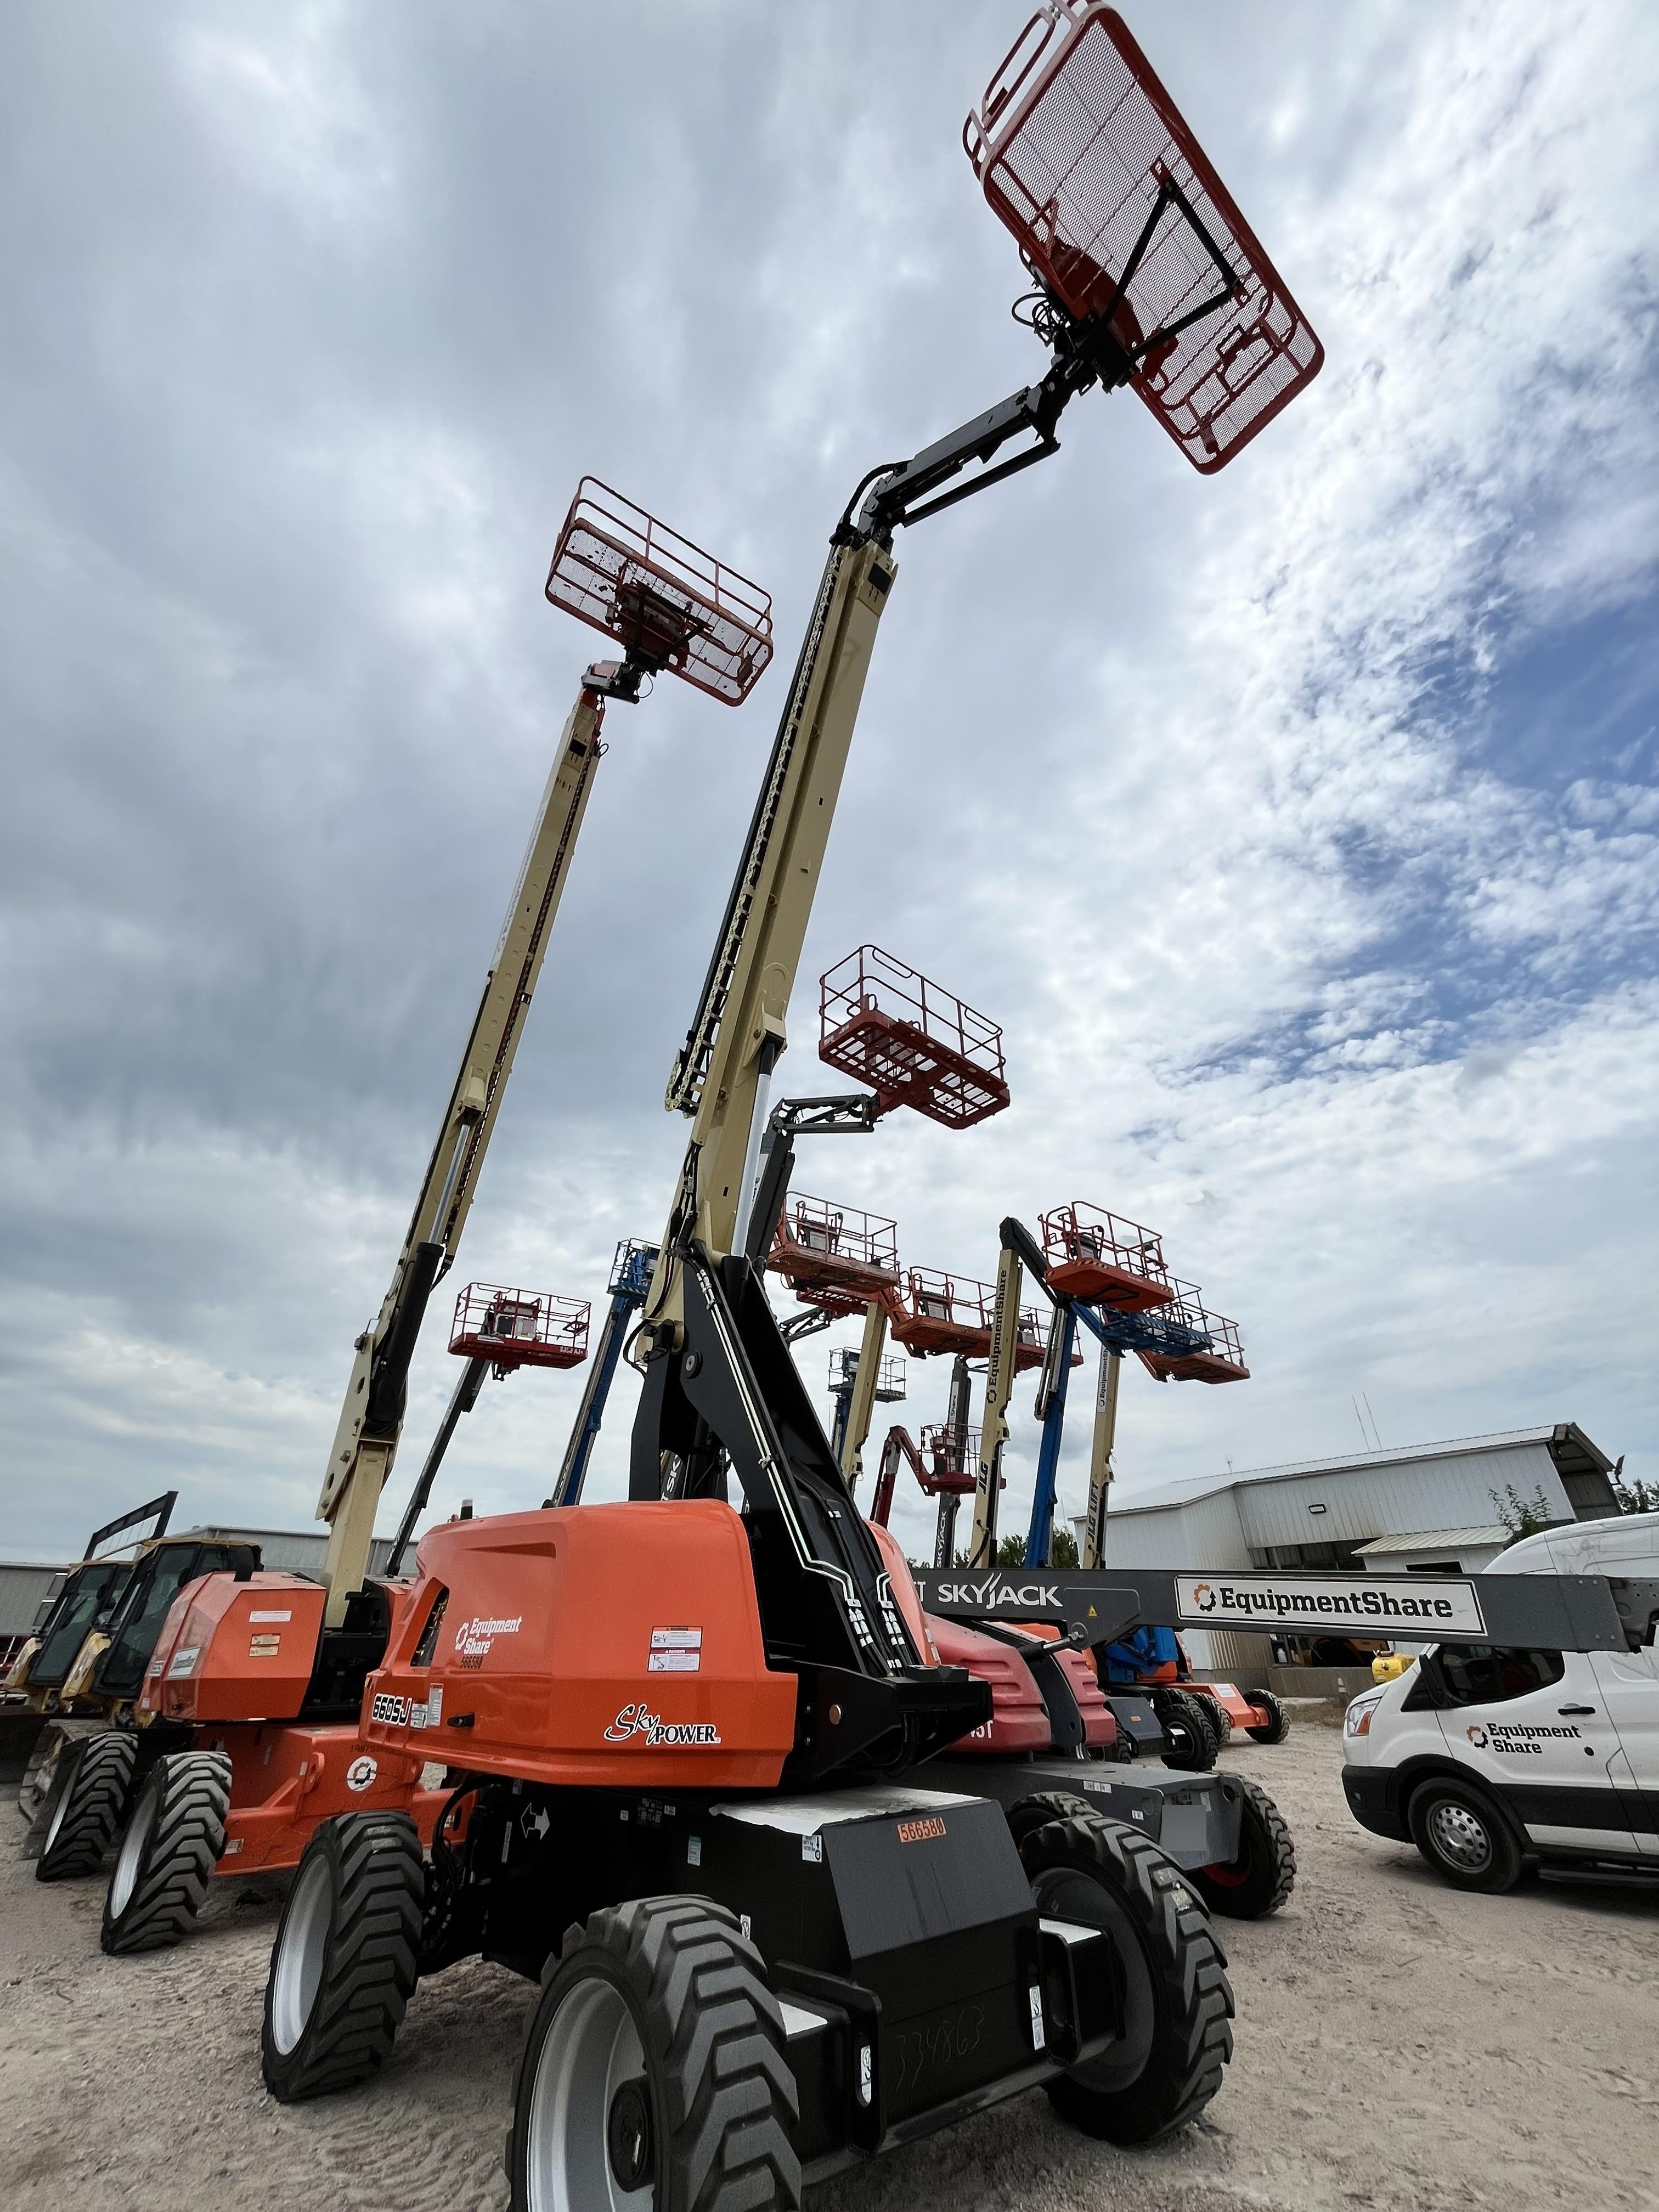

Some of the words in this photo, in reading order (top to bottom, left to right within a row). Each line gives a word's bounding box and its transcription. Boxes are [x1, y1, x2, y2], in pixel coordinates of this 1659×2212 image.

[989, 1269, 1007, 1386] EquipmentShare
[978, 1460, 989, 1496] JLG
[1090, 1480, 1099, 1514] LIFT
[936, 1511, 946, 1568] SKYJACK
[1087, 1514, 1097, 1543] JLG
[938, 1572, 1063, 1610] SKYJACK
[1218, 1587, 1454, 1619] EquipmentShare
[470, 1616, 522, 1638] Equipment
[464, 1638, 491, 1655] Share
[372, 1693, 412, 1726] 660SJ
[1486, 1723, 1582, 1740] Equipment
[1492, 1739, 1542, 1754] Share
[900, 1819, 944, 1841] 566580
